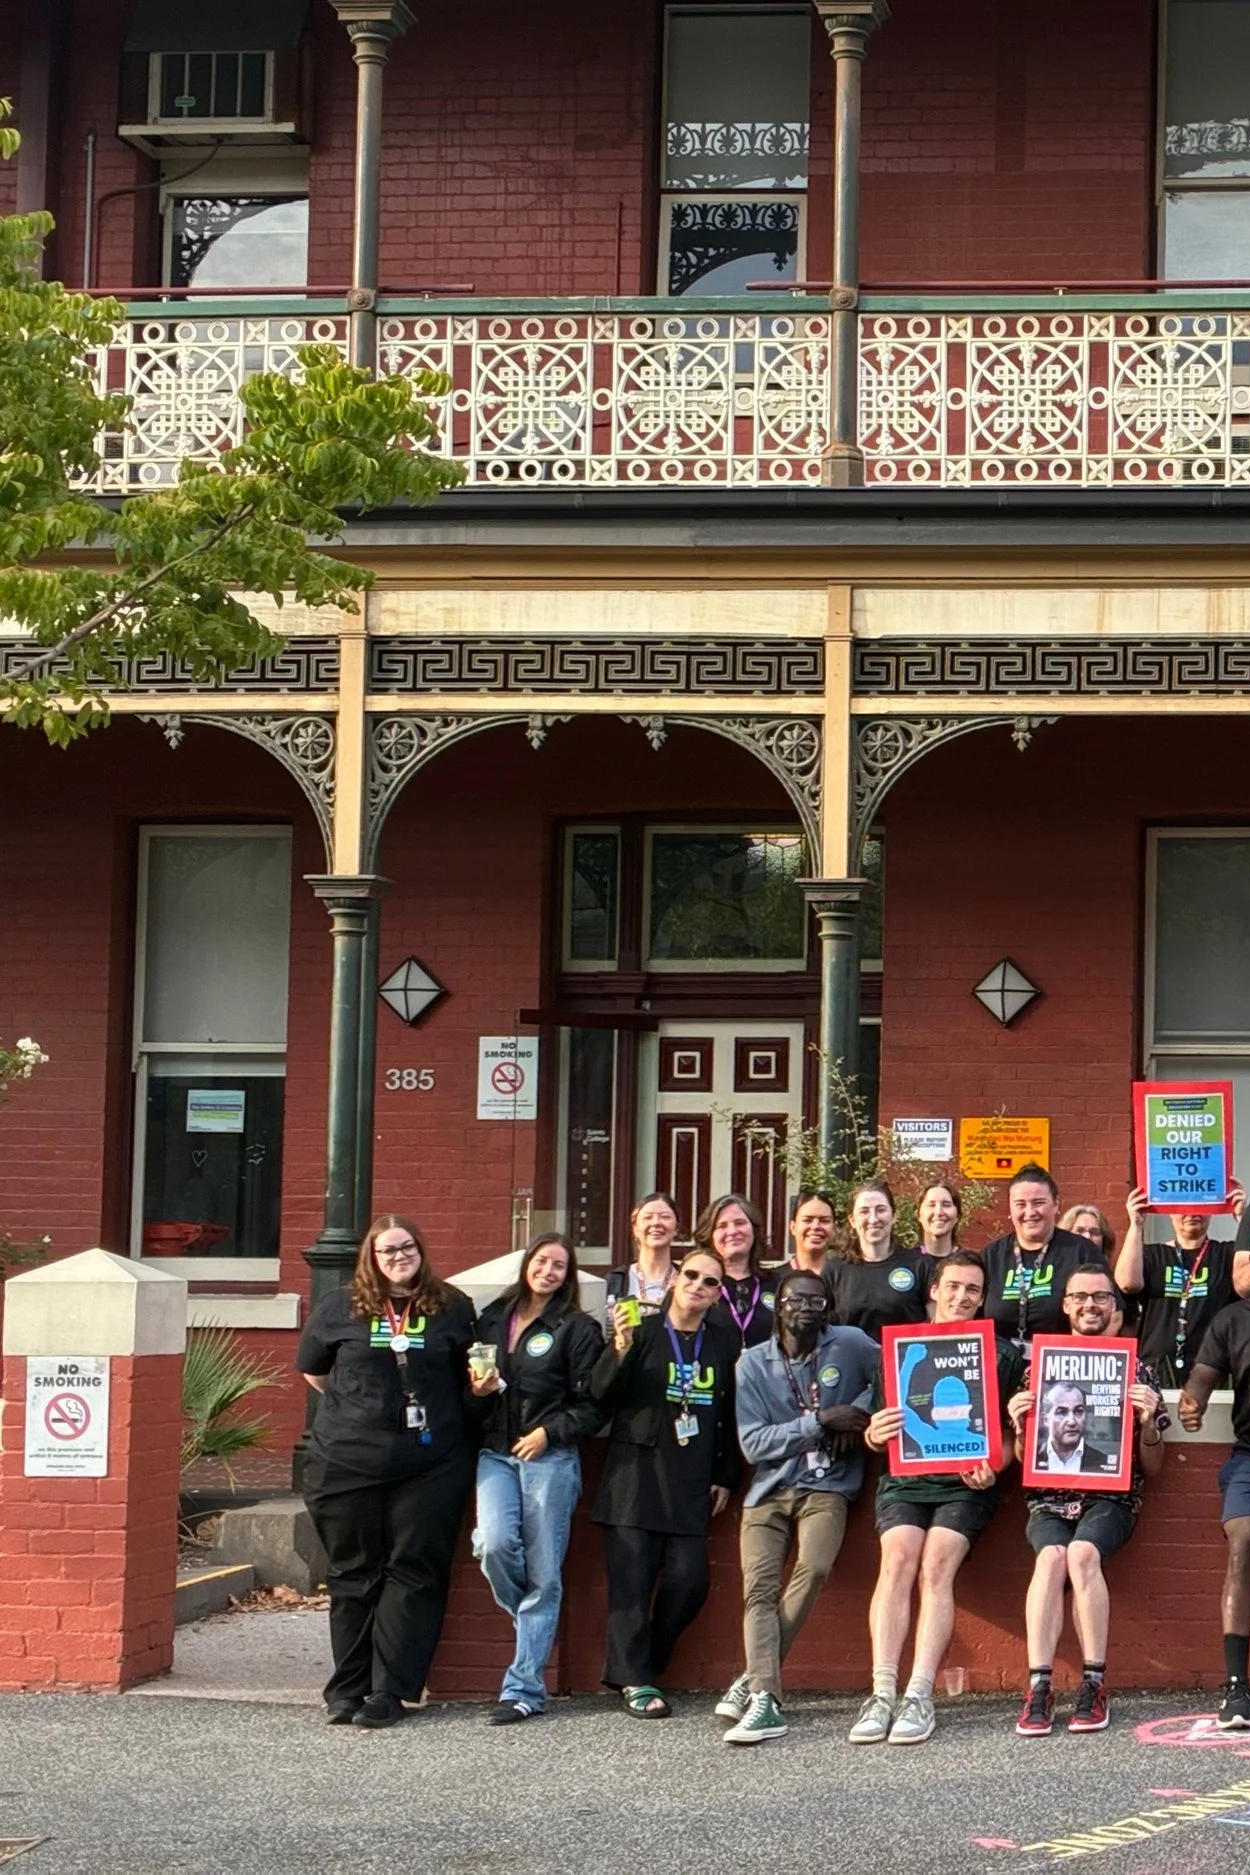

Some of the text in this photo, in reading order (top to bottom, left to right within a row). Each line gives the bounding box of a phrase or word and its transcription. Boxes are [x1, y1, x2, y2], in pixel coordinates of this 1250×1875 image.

[501, 1042, 517, 1050] NO
[484, 1050, 533, 1058] SMOKING
[384, 1068, 435, 1091] 385
[896, 1122, 948, 1132] VISITORS
[1155, 1114, 1217, 1128] DENIED
[1166, 1130, 1203, 1144] OUR
[1161, 1146, 1212, 1160] RIGHT
[1174, 1163, 1199, 1176] TO
[1158, 1179, 1217, 1193] STRIKE
[957, 1343, 979, 1354] WE
[934, 1356, 980, 1369] WON'T
[1045, 1355, 1123, 1381] MERLINO:
[58, 1364, 80, 1375] NO
[963, 1370, 980, 1381] BE
[34, 1376, 102, 1388] SMOKING
[1091, 1384, 1121, 1395] DENYING
[924, 1442, 985, 1455] SILENCED!
[1018, 1815, 1179, 1859] ZONE
